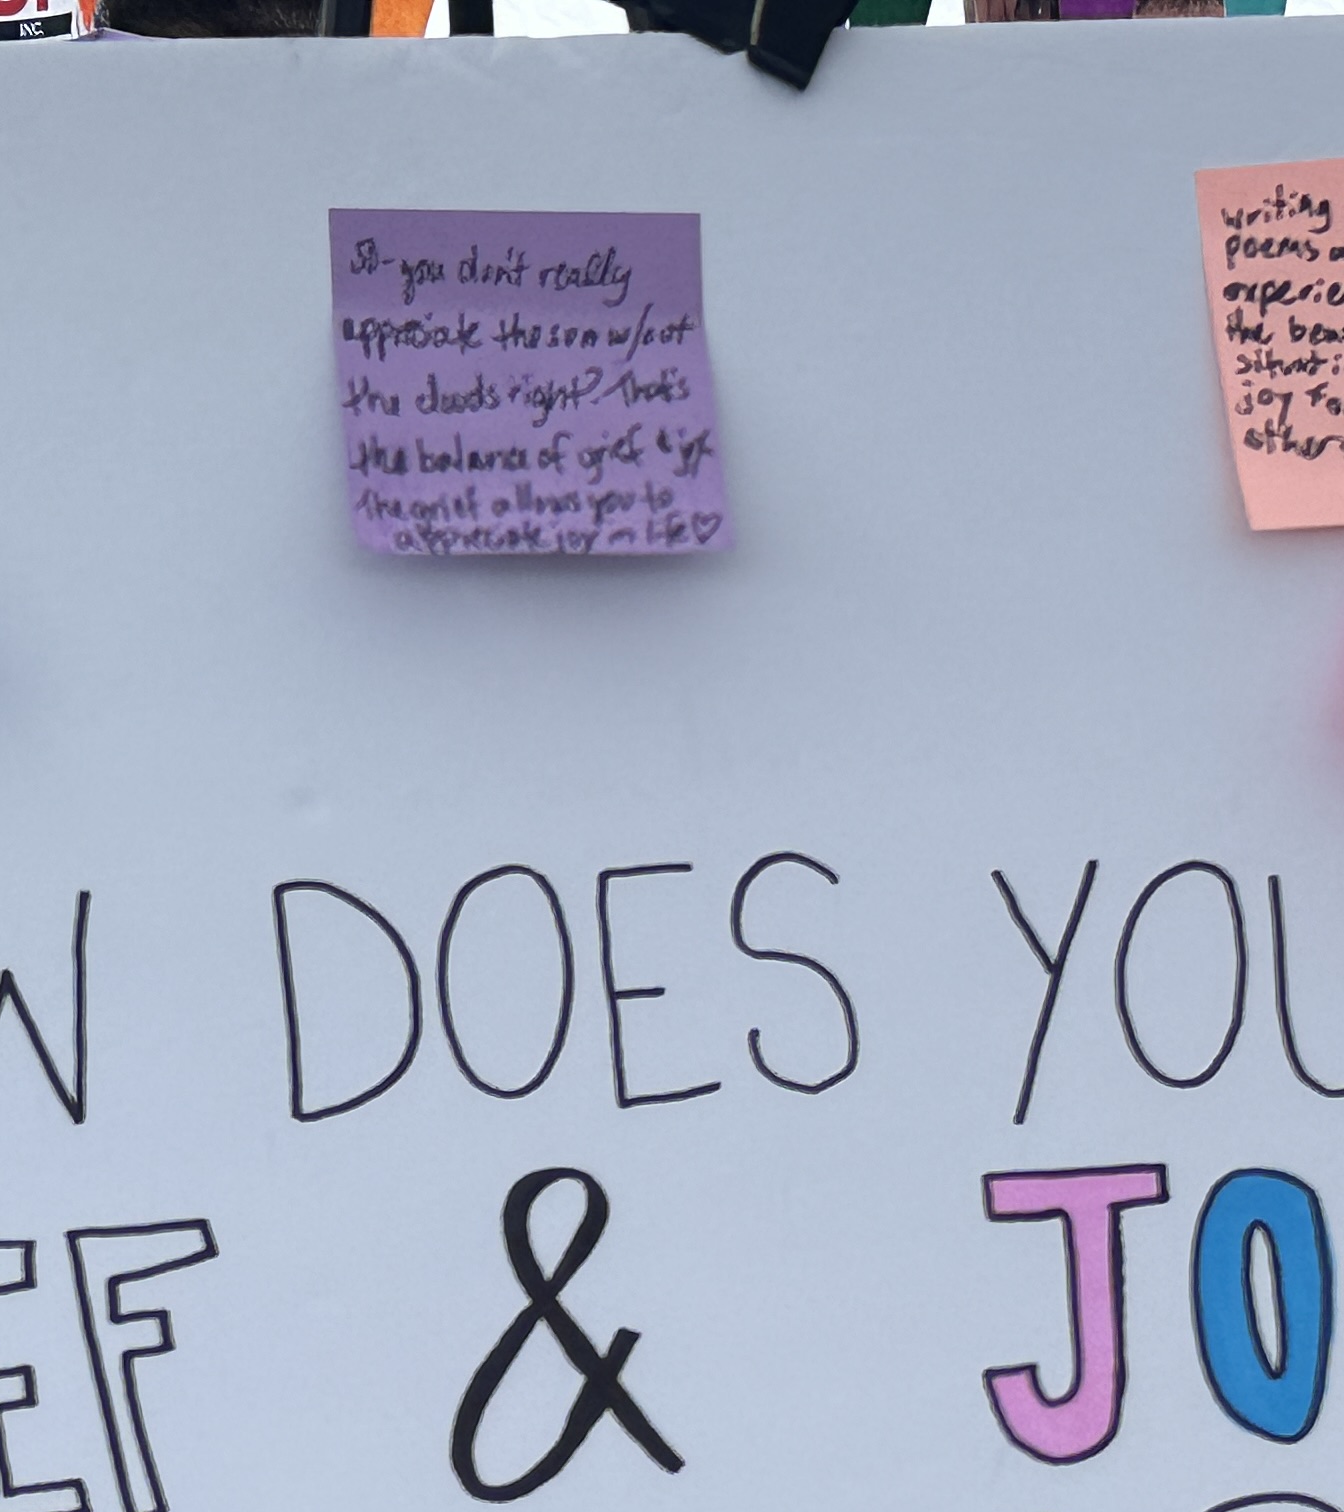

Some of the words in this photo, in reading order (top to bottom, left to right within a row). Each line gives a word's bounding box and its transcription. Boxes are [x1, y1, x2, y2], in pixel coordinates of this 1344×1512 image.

[459, 244, 529, 287] don't
[538, 247, 632, 308] really
[272, 849, 862, 1124] DOES
[447, 1164, 685, 1502] &
